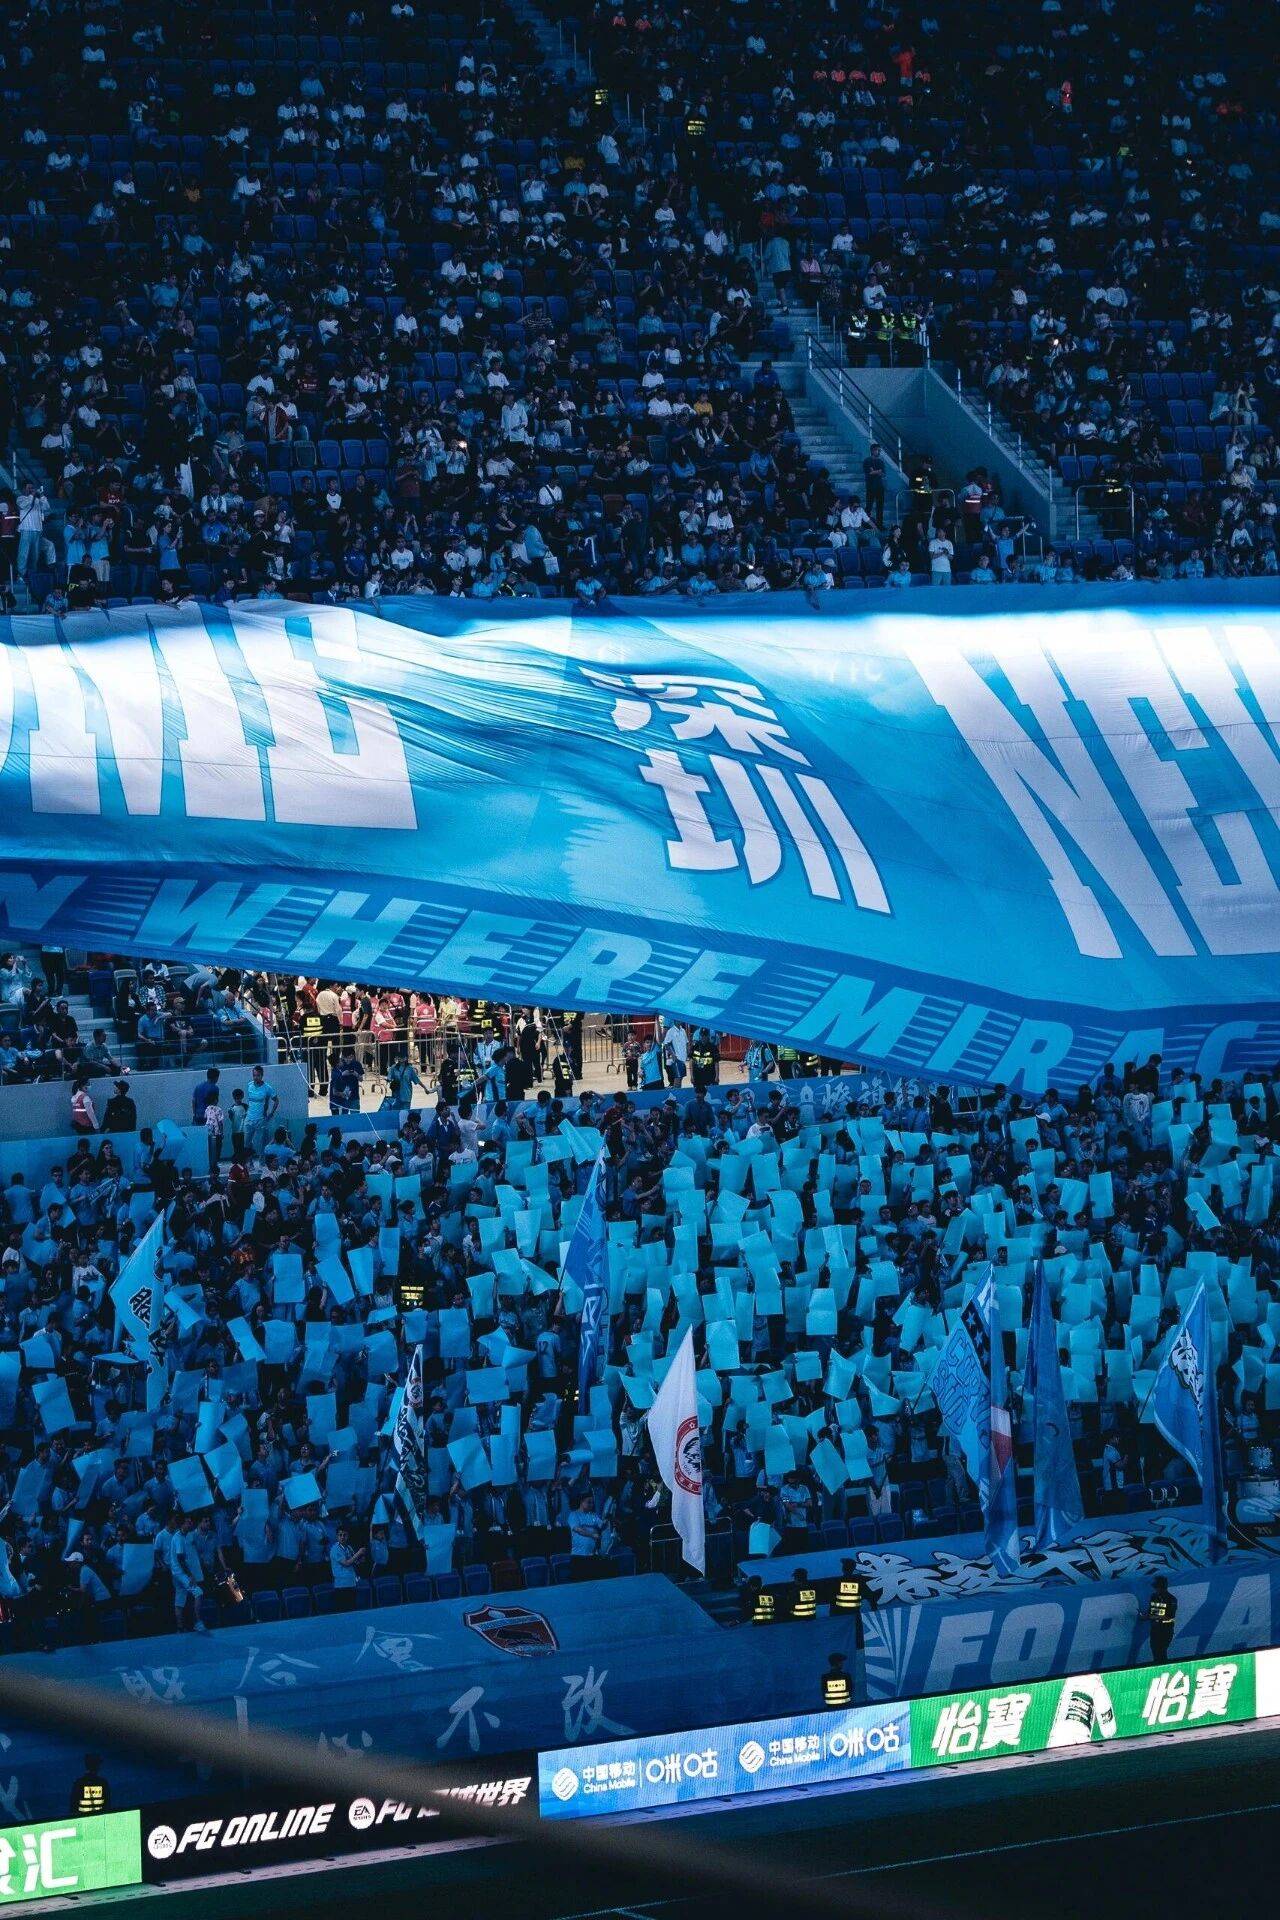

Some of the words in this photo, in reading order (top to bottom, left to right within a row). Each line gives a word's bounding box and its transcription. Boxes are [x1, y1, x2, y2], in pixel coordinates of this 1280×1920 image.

[0, 595, 417, 830] ME
[577, 665, 892, 915] 深圳
[132, 878, 767, 1020] WHERE
[922, 1573, 1272, 1694] FORZA
[931, 1692, 1032, 1757] 怡寶
[1142, 1663, 1238, 1726] 怡寶
[582, 1760, 636, 1783] 中国移动
[769, 1733, 820, 1755] 中国移动
[769, 1756, 793, 1767] China
[793, 1752, 820, 1764] Mobile
[583, 1780, 607, 1794] China
[608, 1777, 636, 1791] Mobile
[175, 1819, 223, 1854] FC
[220, 1803, 336, 1847] ONLINE
[0, 1826, 80, 1896] 汇
